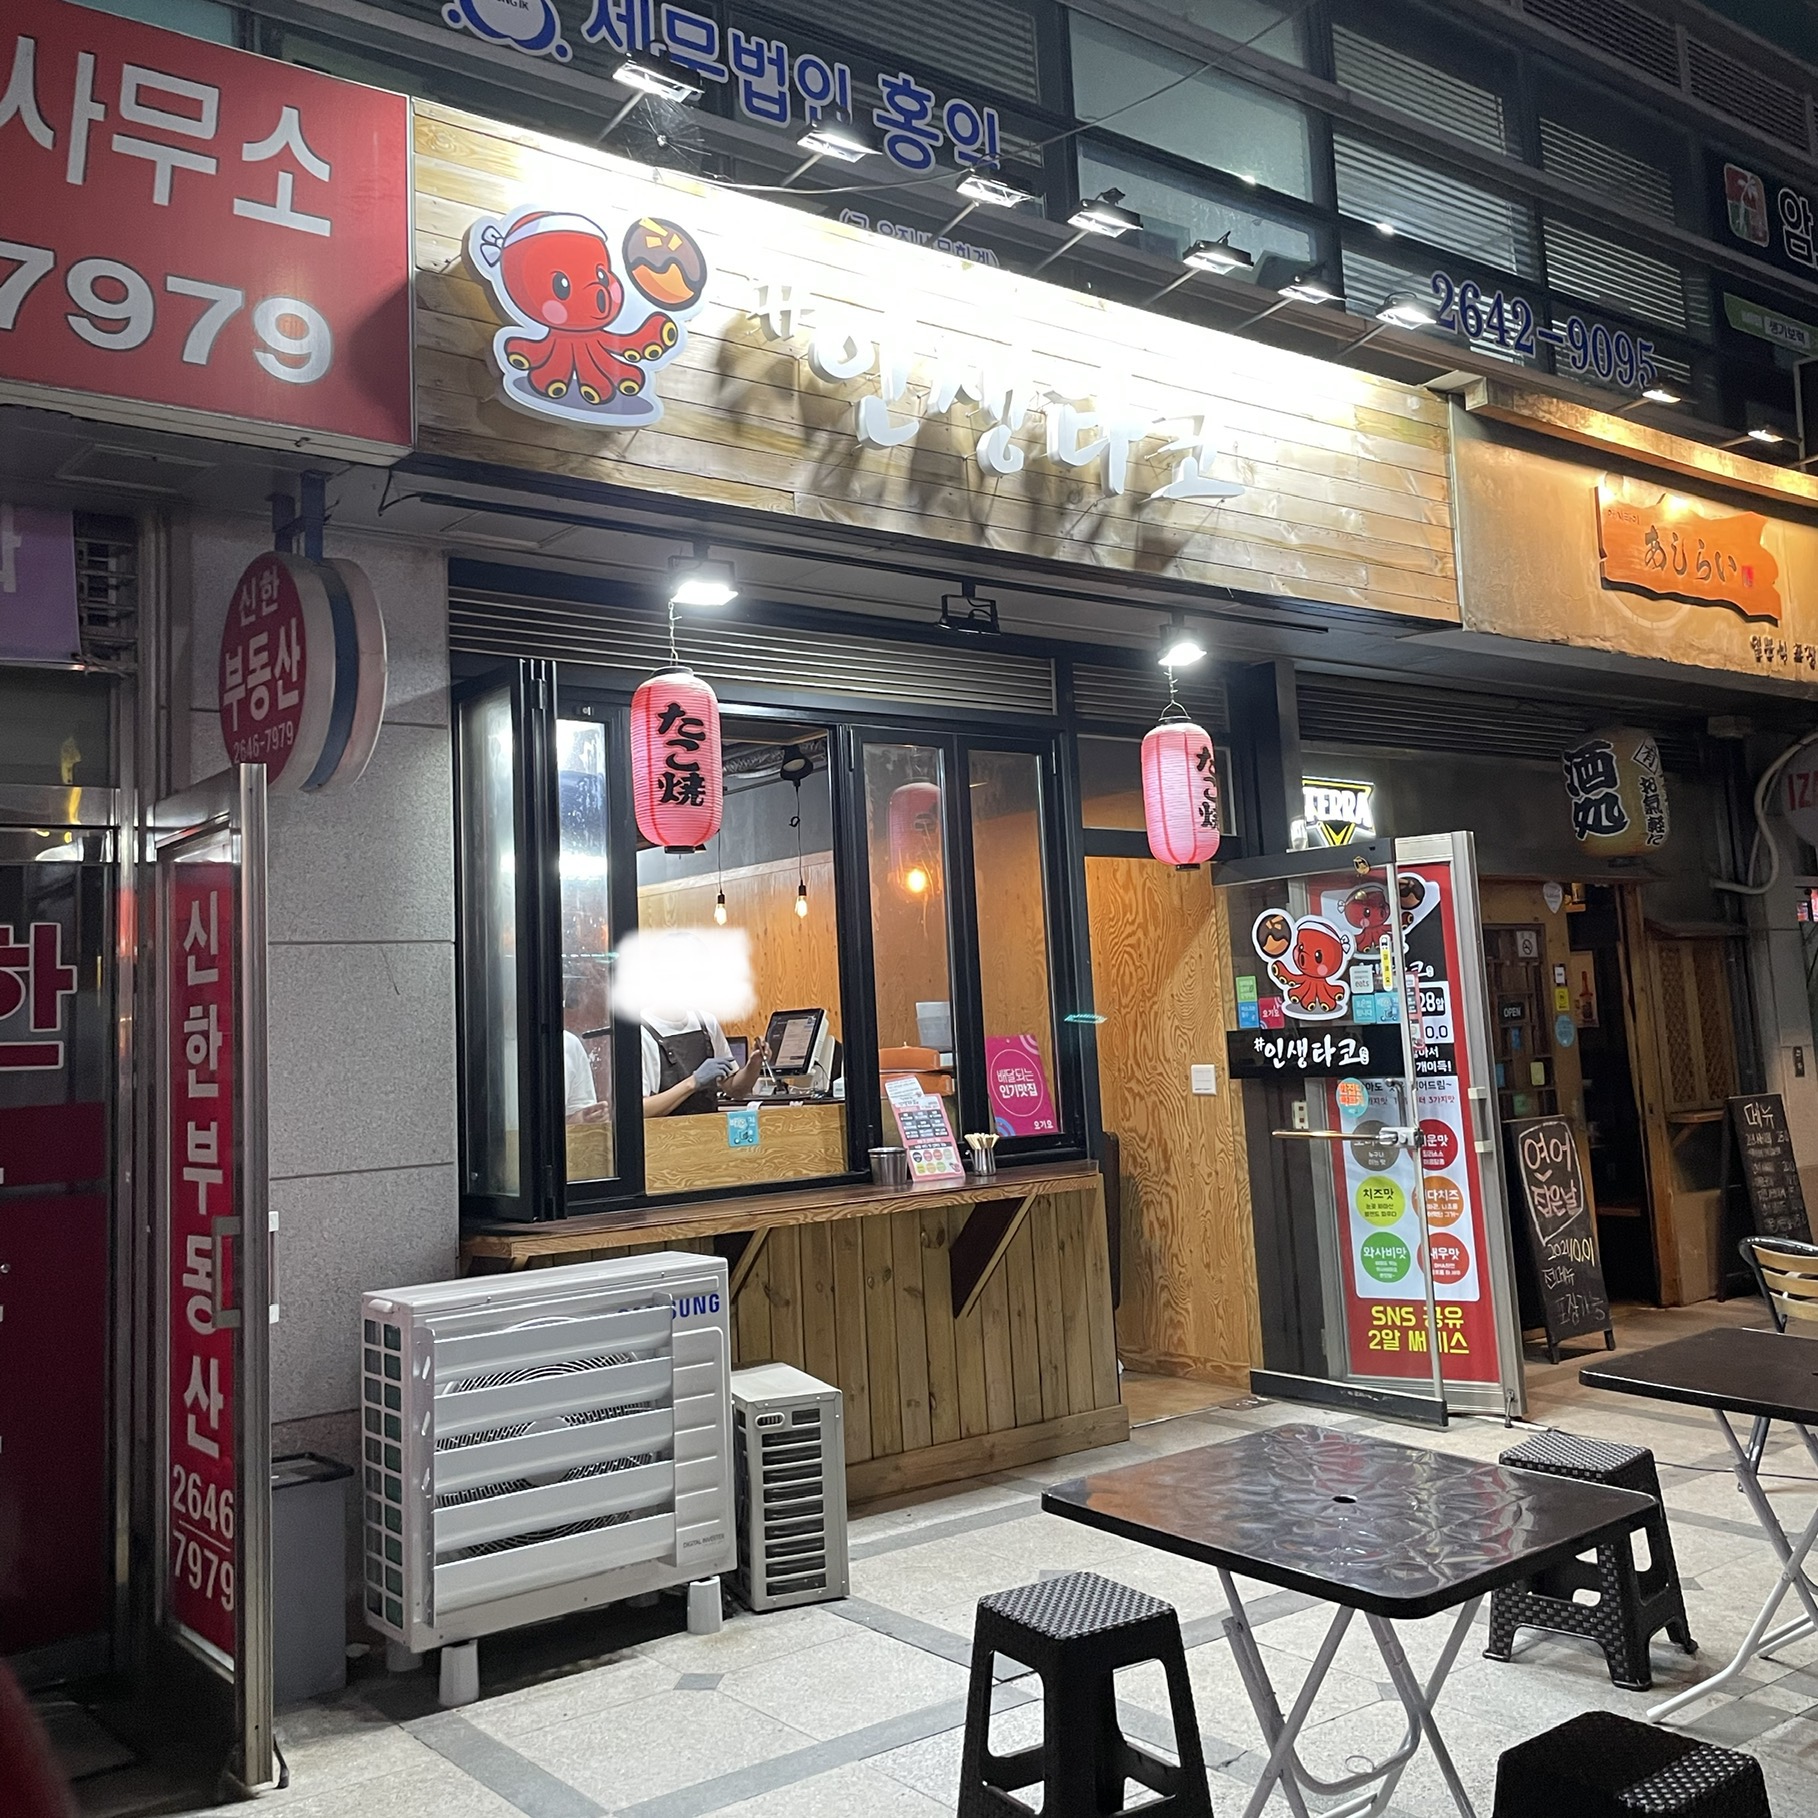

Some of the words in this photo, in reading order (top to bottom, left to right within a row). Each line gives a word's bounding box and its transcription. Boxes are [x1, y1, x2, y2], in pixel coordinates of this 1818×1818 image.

[0, 35, 333, 238] 사무소
[873, 72, 1001, 171] 홍익
[0, 240, 334, 386] 7979
[1430, 270, 1662, 391] 2642-9095
[1644, 524, 1737, 582] あしらい
[238, 565, 280, 627] 신한
[222, 617, 301, 732] 부동산
[657, 702, 706, 807] たこ焼
[1302, 785, 1374, 830] TERRA
[1503, 1006, 1522, 1018] OPEN
[1253, 1033, 1362, 1071] #인생타코
[1416, 1060, 1453, 1073] 개이득!
[996, 1066, 1035, 1084] 배달되는
[1000, 1082, 1039, 1100] 인기맛집
[1362, 1187, 1395, 1201] 치즈맛
[1425, 1188, 1460, 1202] 다치즈
[1363, 1246, 1408, 1259] 와사비맛
[1371, 1305, 1417, 1327] SNS
[1367, 1329, 1402, 1352] 2알
[171, 1464, 235, 1541] 2646
[172, 1528, 235, 1613] 7979
